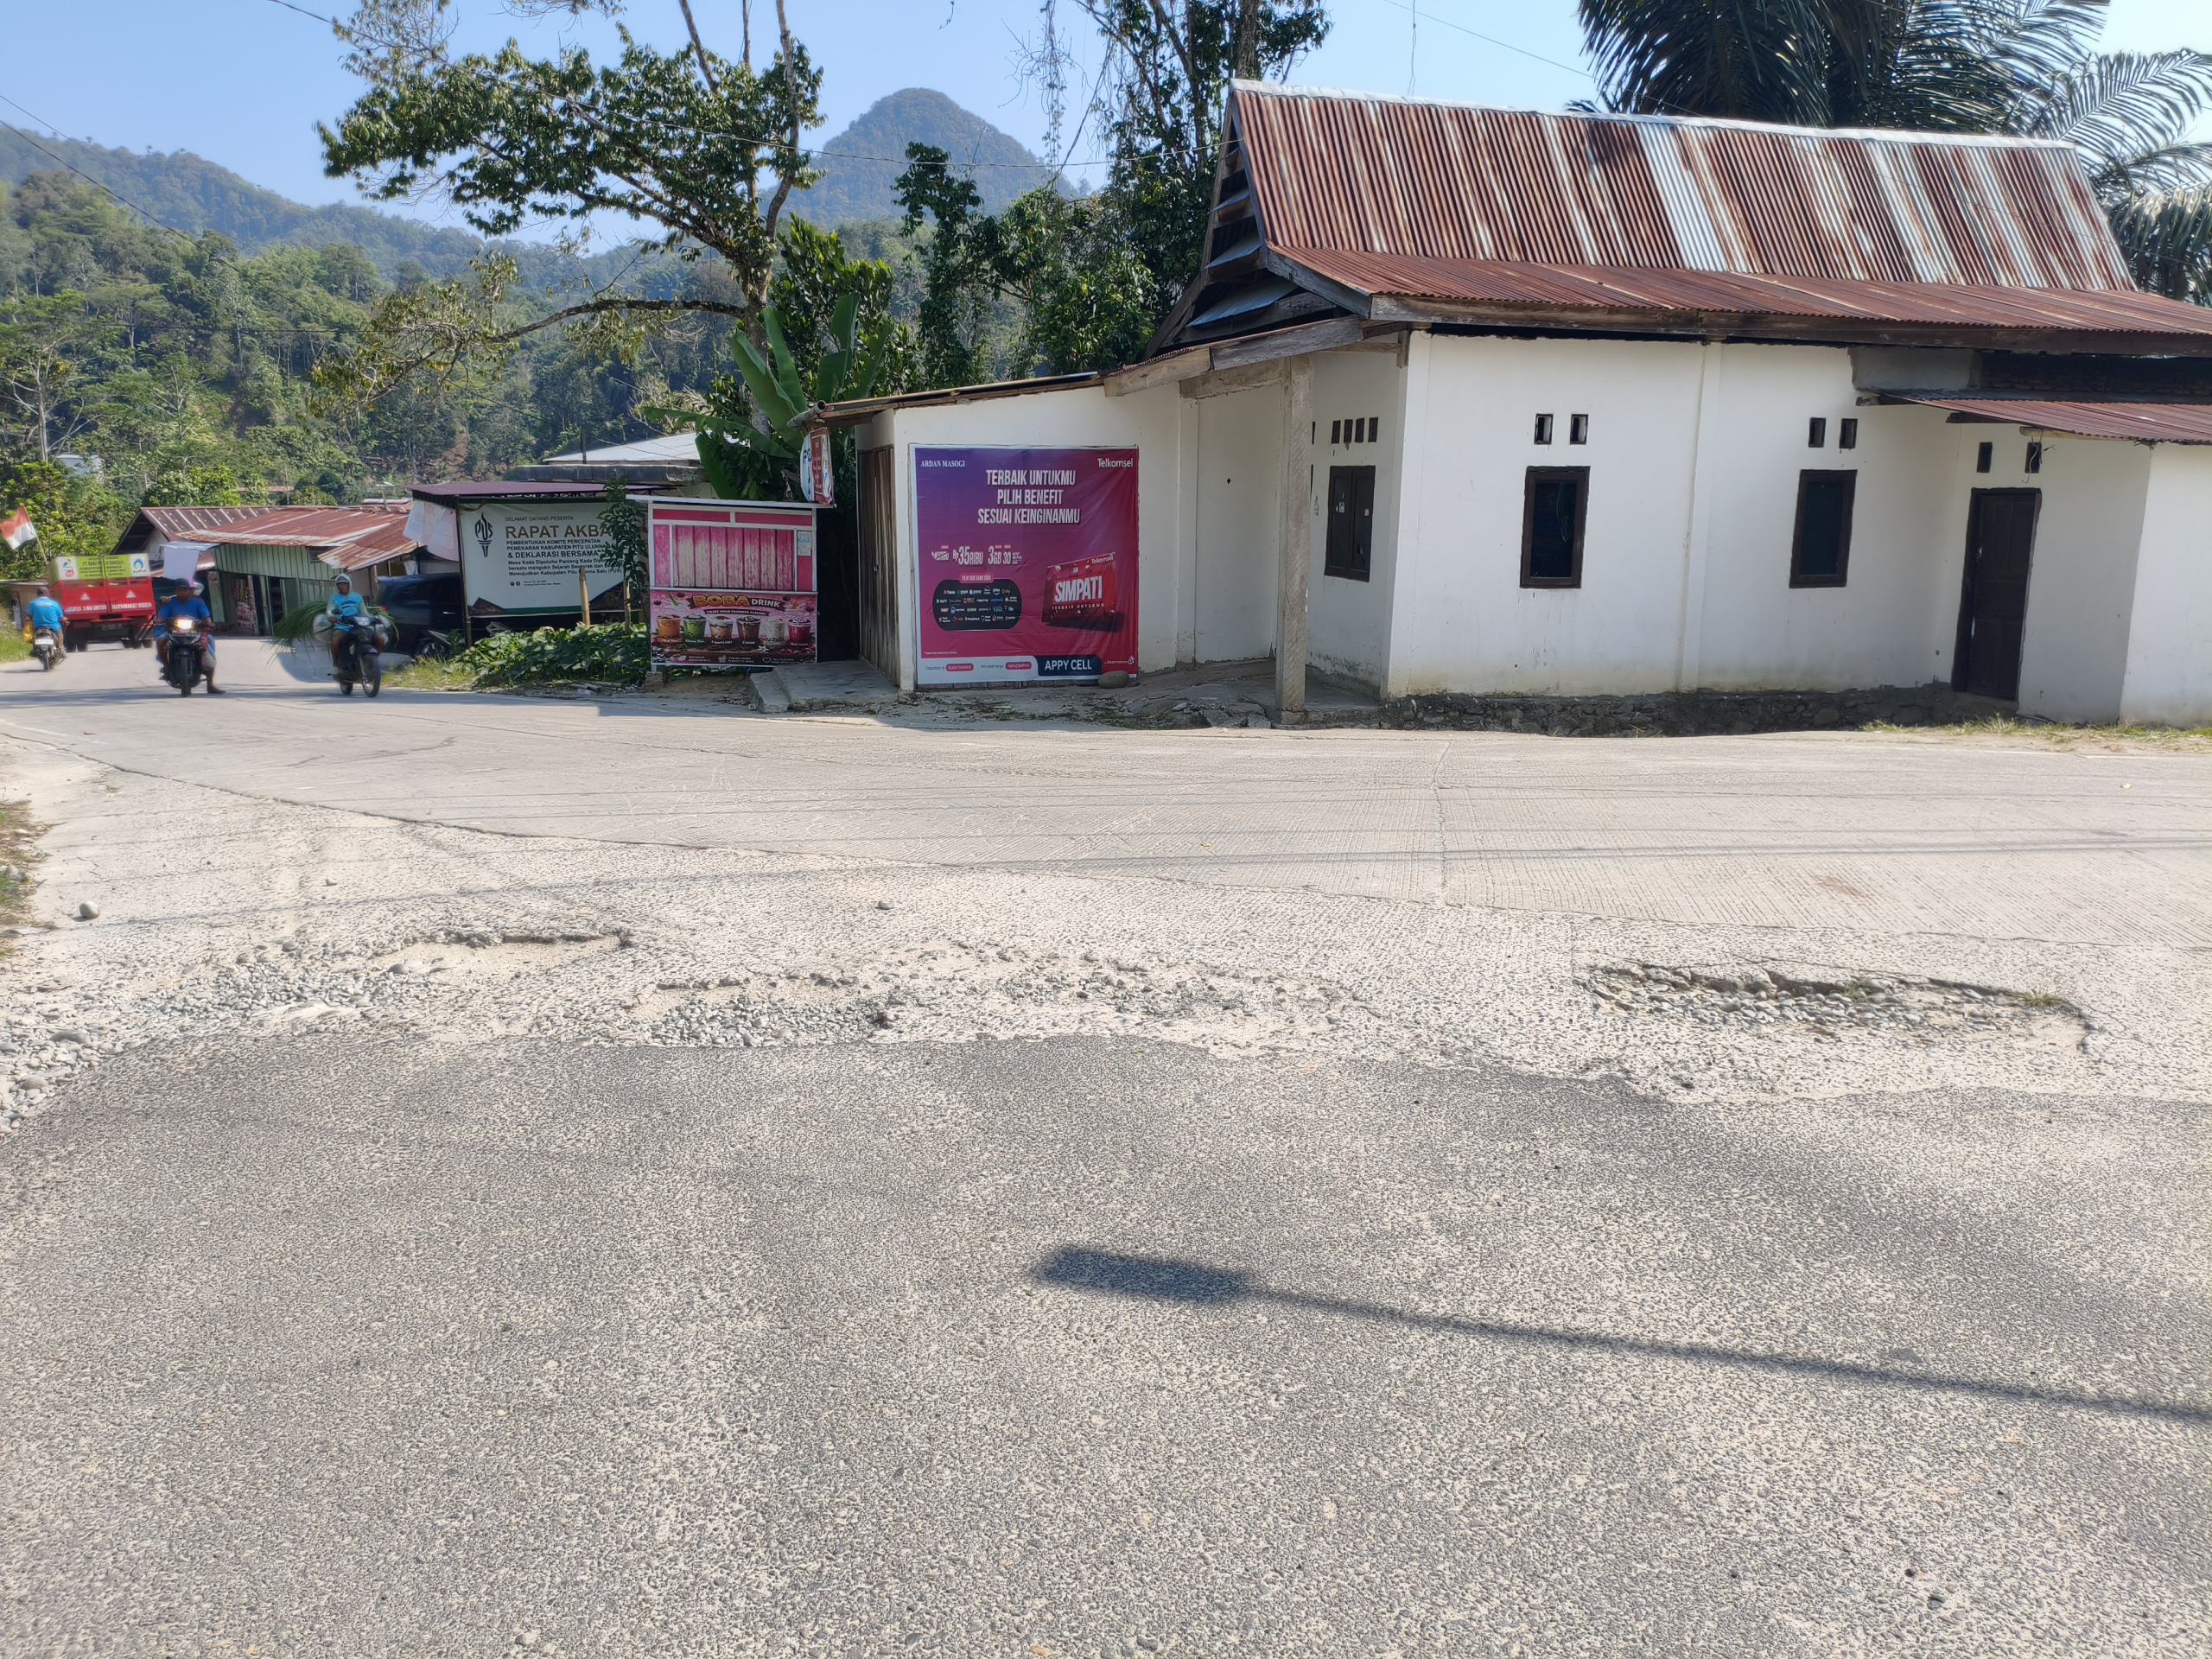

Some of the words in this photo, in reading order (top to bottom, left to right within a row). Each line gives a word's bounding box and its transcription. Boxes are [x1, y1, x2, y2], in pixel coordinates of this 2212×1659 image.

[1097, 458, 1134, 467] Telkomsel
[986, 469, 1027, 486] TERBAIK
[1029, 469, 1076, 486] UNTUKMU
[997, 489, 1022, 505] PILIH
[1024, 489, 1064, 505] BENEFIT
[977, 508, 1012, 524] SESUAI
[1014, 508, 1080, 524] KEINGINANMU
[505, 524, 559, 538] RAPAT
[564, 524, 614, 537] AKBA
[1090, 554, 1114, 565] Telkomsel
[1054, 575, 1103, 602] SIMPATI
[692, 594, 751, 607] BOBA
[751, 598, 782, 607] DRINK
[1044, 659, 1070, 671] APPY
[1070, 659, 1093, 671] CELL
